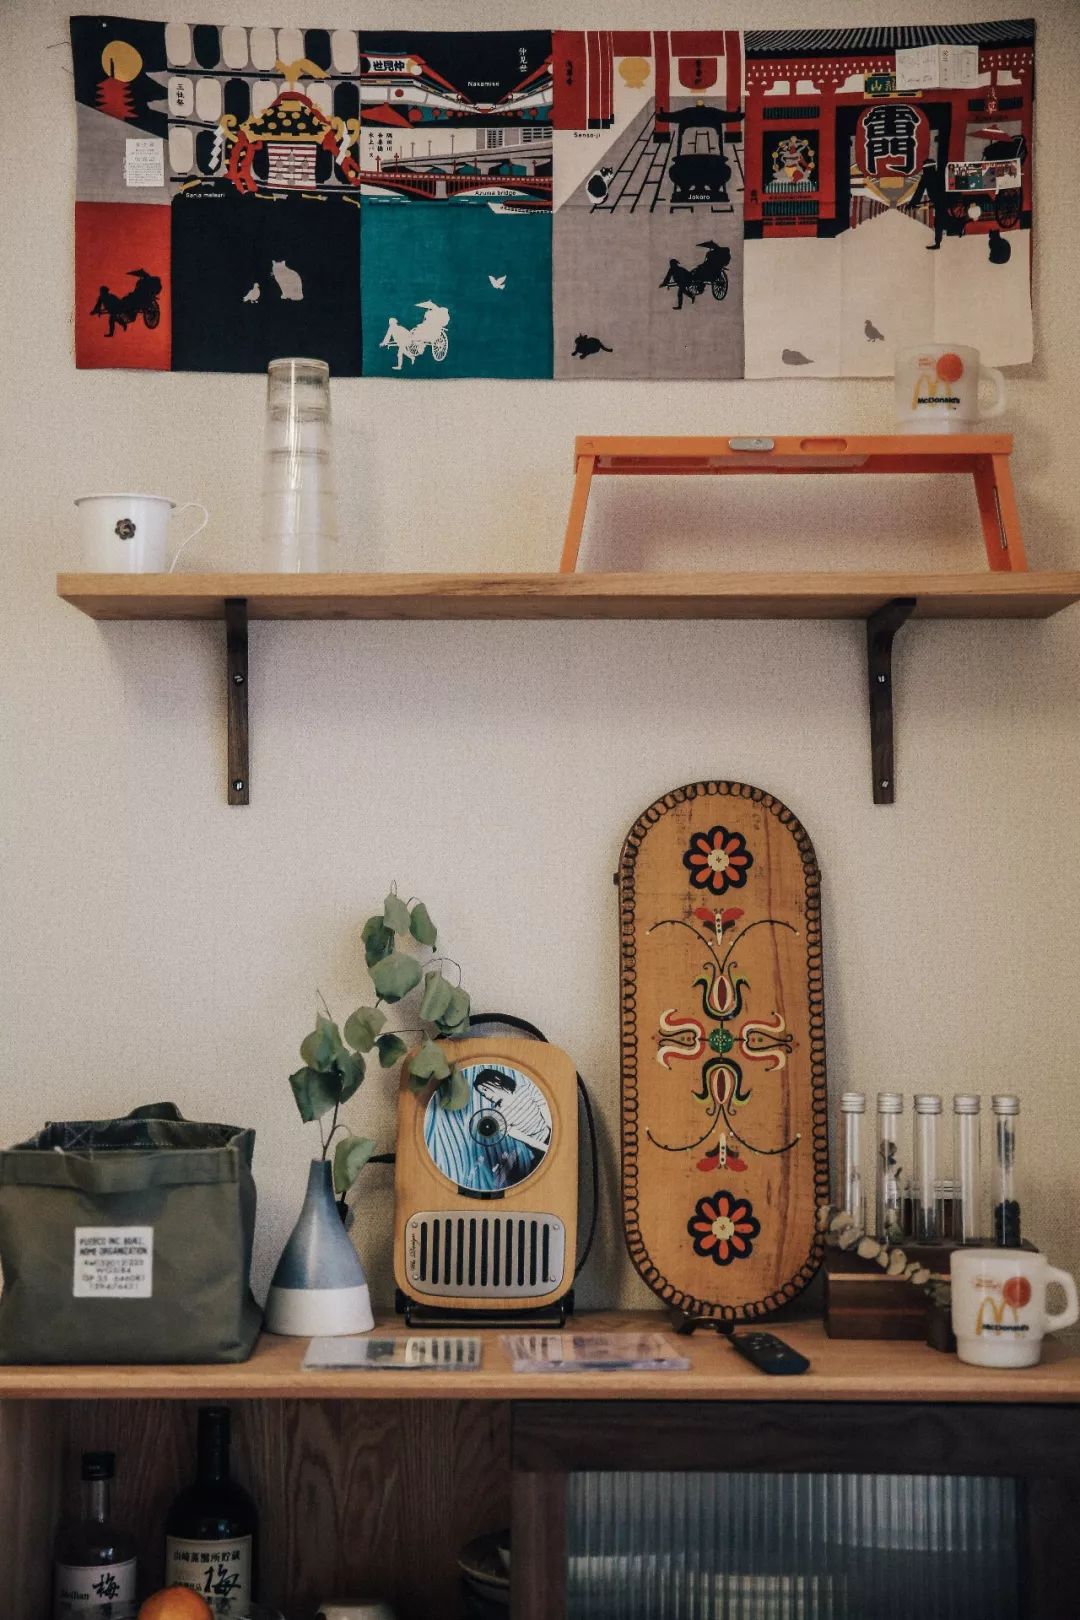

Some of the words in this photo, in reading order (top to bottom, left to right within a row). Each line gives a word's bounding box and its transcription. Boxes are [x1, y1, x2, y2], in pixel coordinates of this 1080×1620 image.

[518, 47, 528, 73] 仲見世
[80, 1247, 97, 1256] HOME
